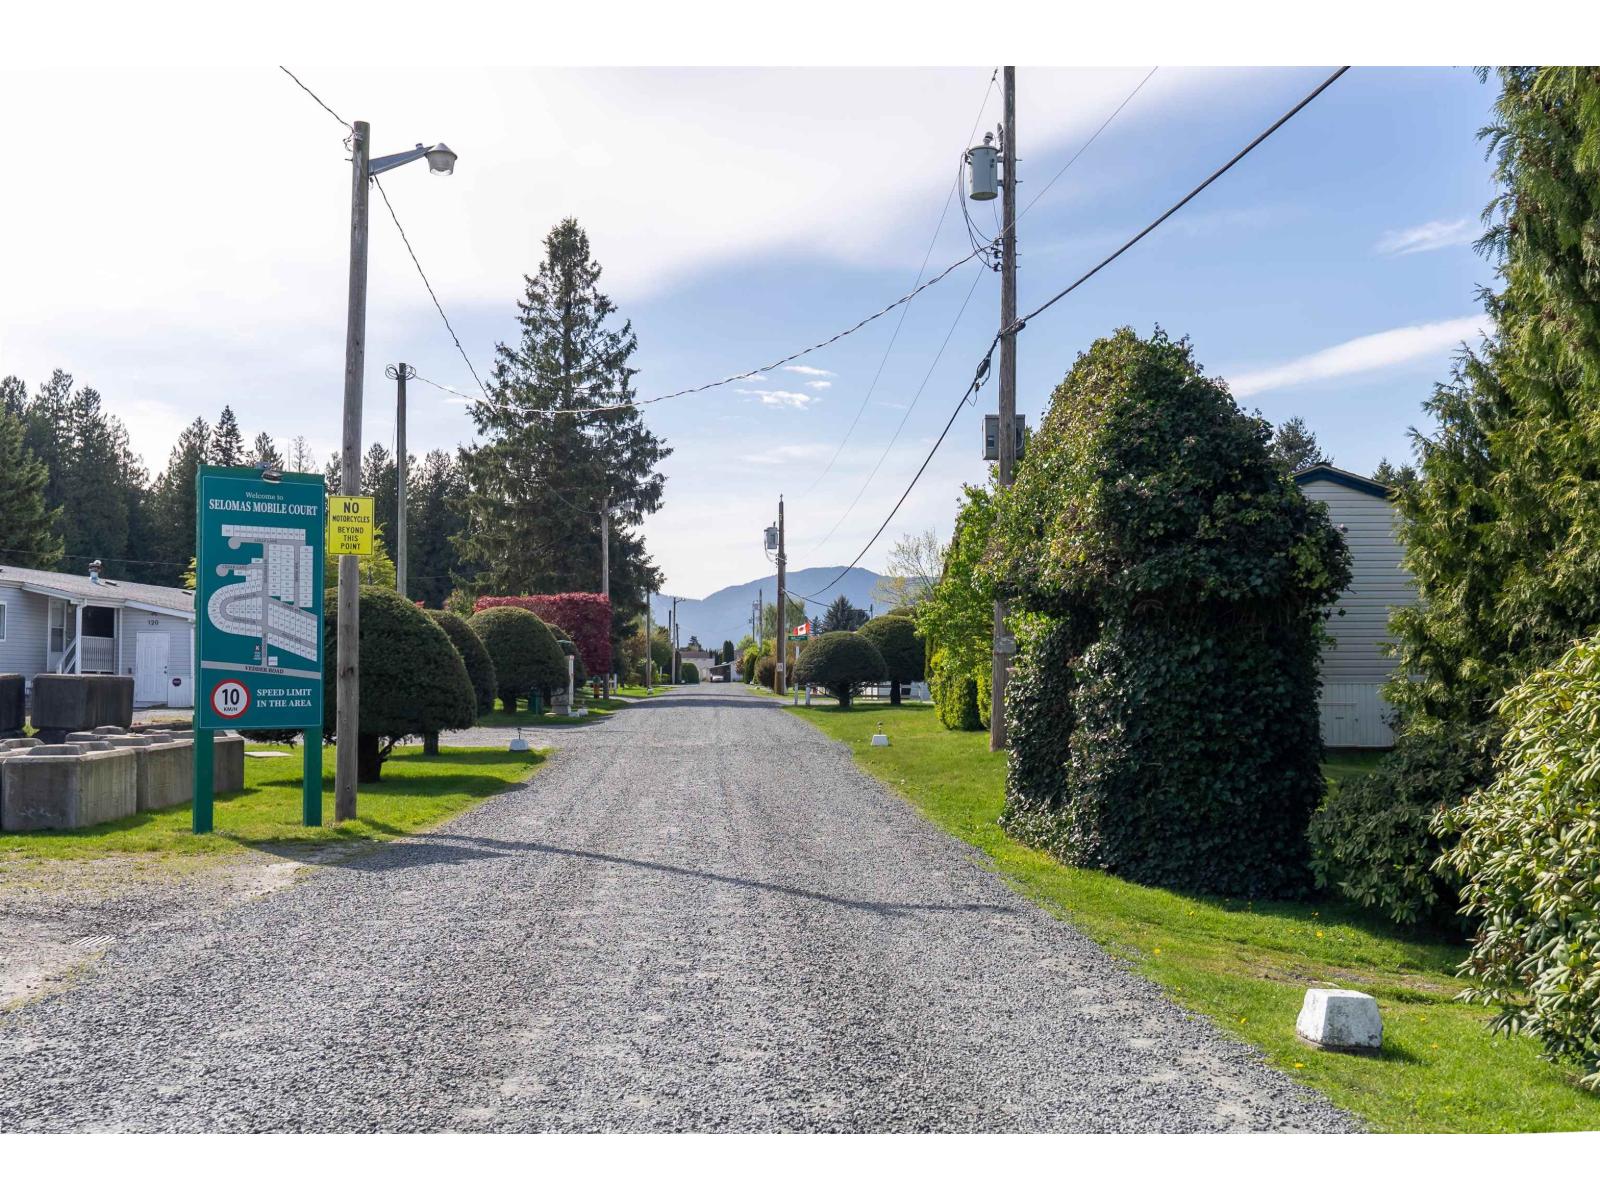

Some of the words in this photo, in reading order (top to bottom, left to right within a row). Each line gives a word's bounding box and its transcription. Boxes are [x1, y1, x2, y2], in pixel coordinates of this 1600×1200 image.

[246, 491, 276, 500] Welcome
[209, 498, 251, 512] SELOMAS
[252, 502, 287, 514] MOBILE
[288, 504, 318, 516] COURT
[344, 502, 359, 513] NO
[332, 515, 370, 523] MOTORCYCLES
[222, 688, 240, 705] 10
